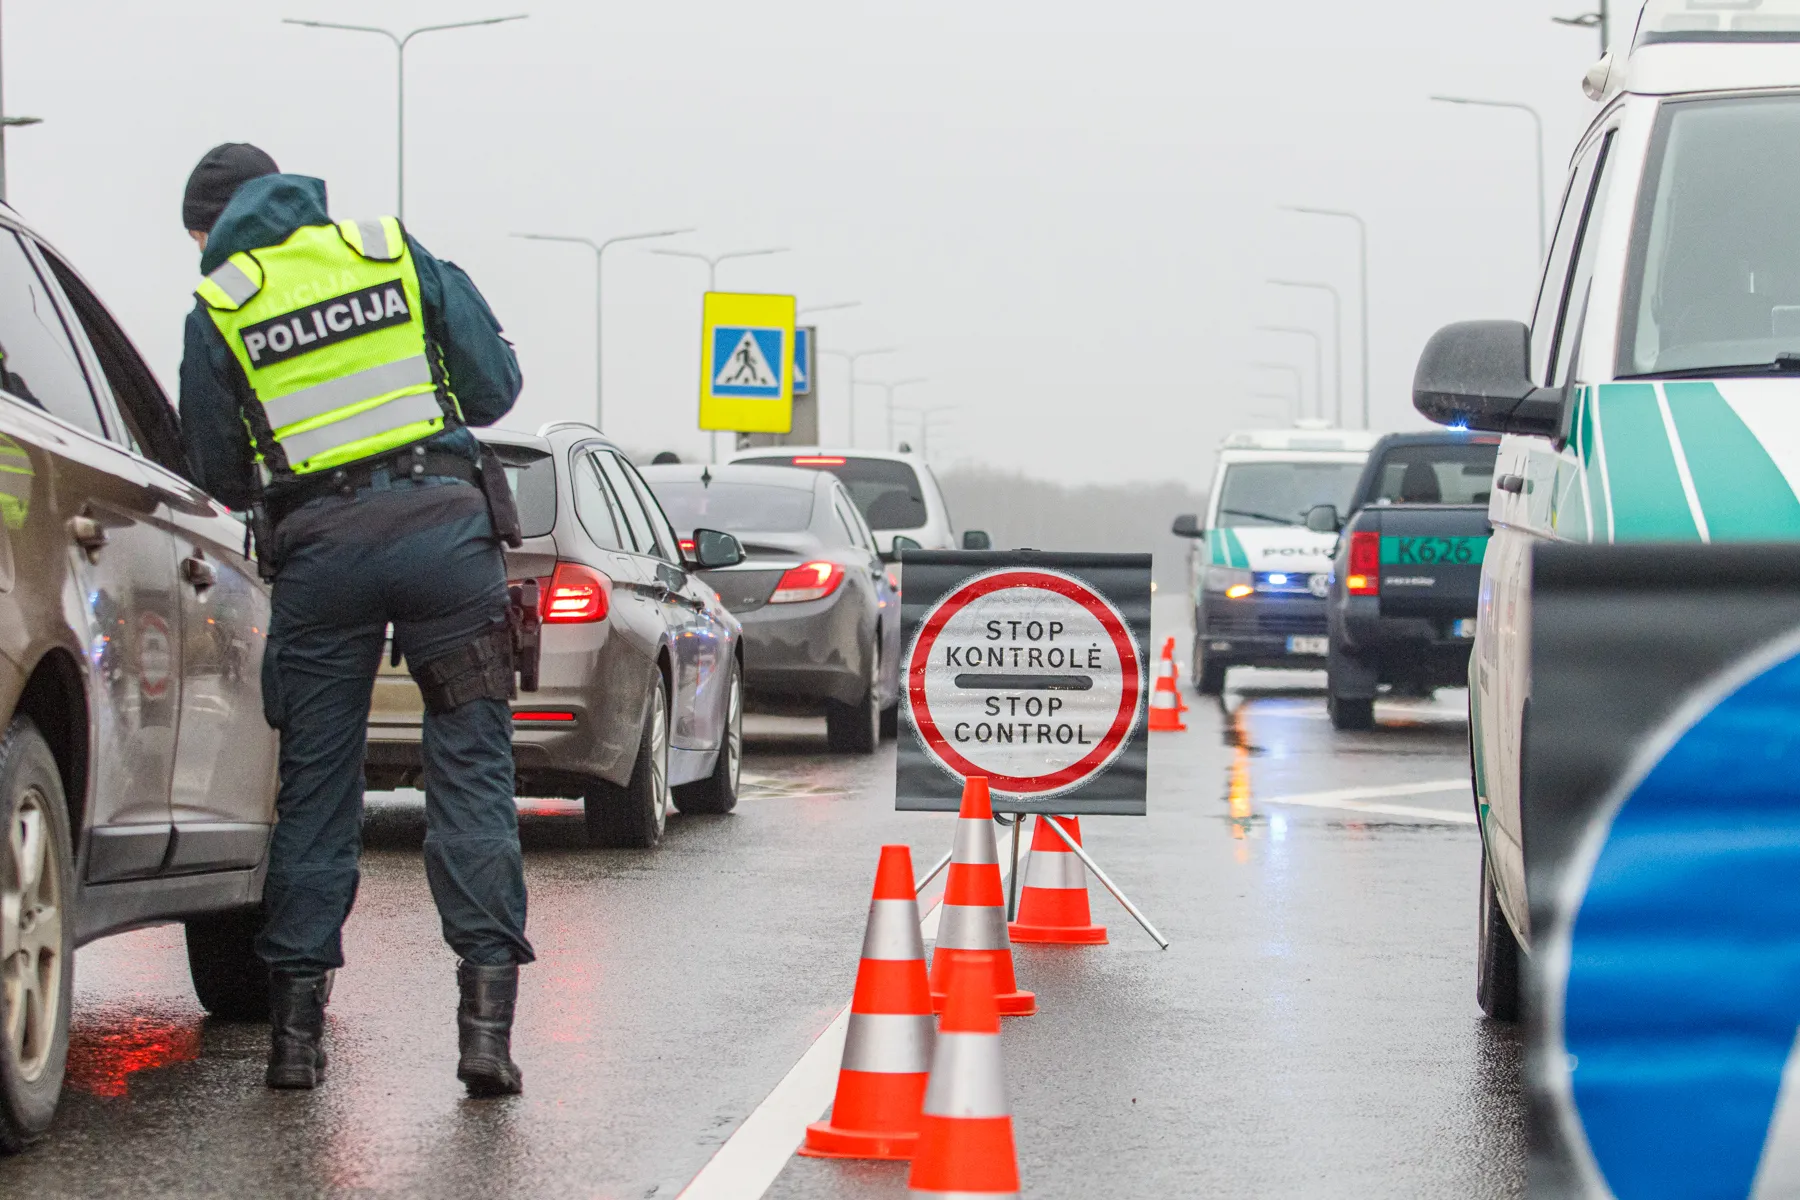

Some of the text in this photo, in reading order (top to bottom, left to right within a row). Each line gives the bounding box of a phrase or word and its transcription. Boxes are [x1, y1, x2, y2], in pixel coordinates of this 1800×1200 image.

[246, 288, 409, 362] POLICIJA
[1399, 536, 1472, 564] K626
[986, 620, 1063, 641] STOP
[946, 643, 1102, 669] KONTROLĖ
[985, 696, 1062, 717] STOP
[954, 722, 1091, 745] CONTROL
